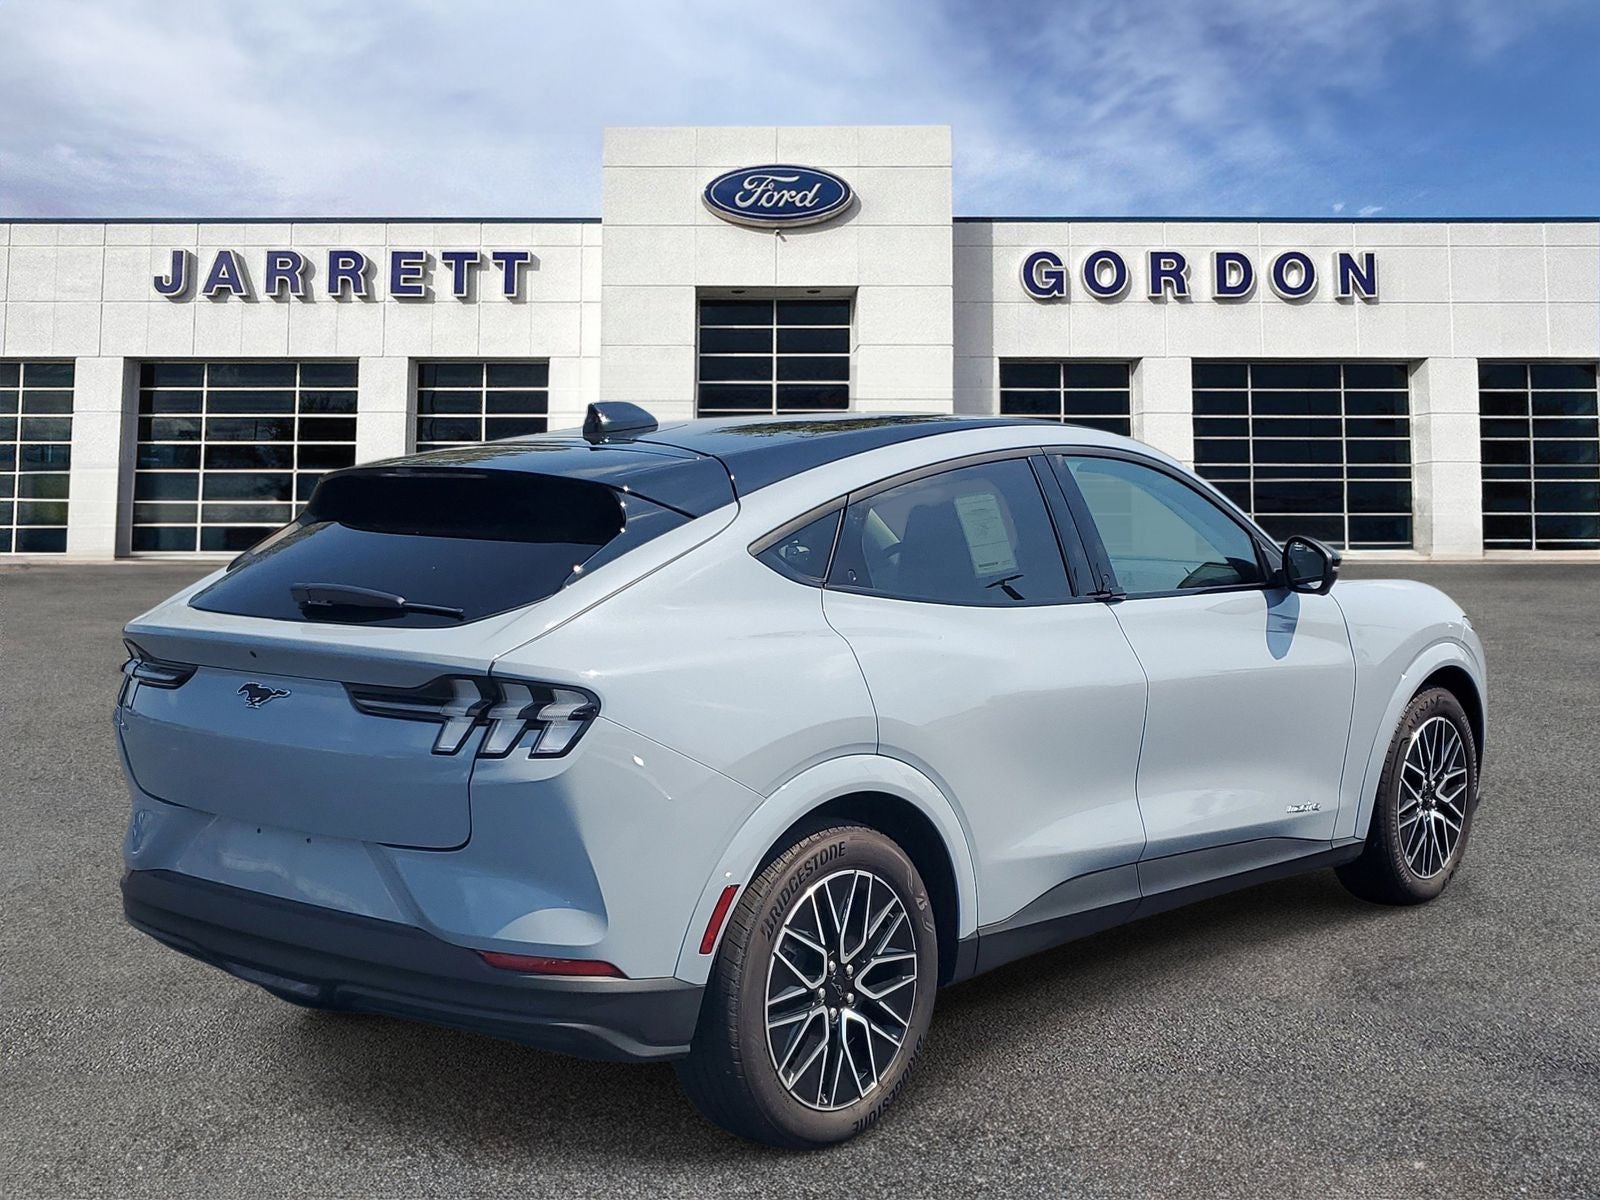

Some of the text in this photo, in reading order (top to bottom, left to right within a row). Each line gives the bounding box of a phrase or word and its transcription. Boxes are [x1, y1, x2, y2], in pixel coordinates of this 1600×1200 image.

[735, 174, 821, 208] Ford
[153, 248, 531, 298] JARRETT
[1021, 250, 1379, 299] GORDON
[763, 841, 846, 942] BRIDGESTONE
